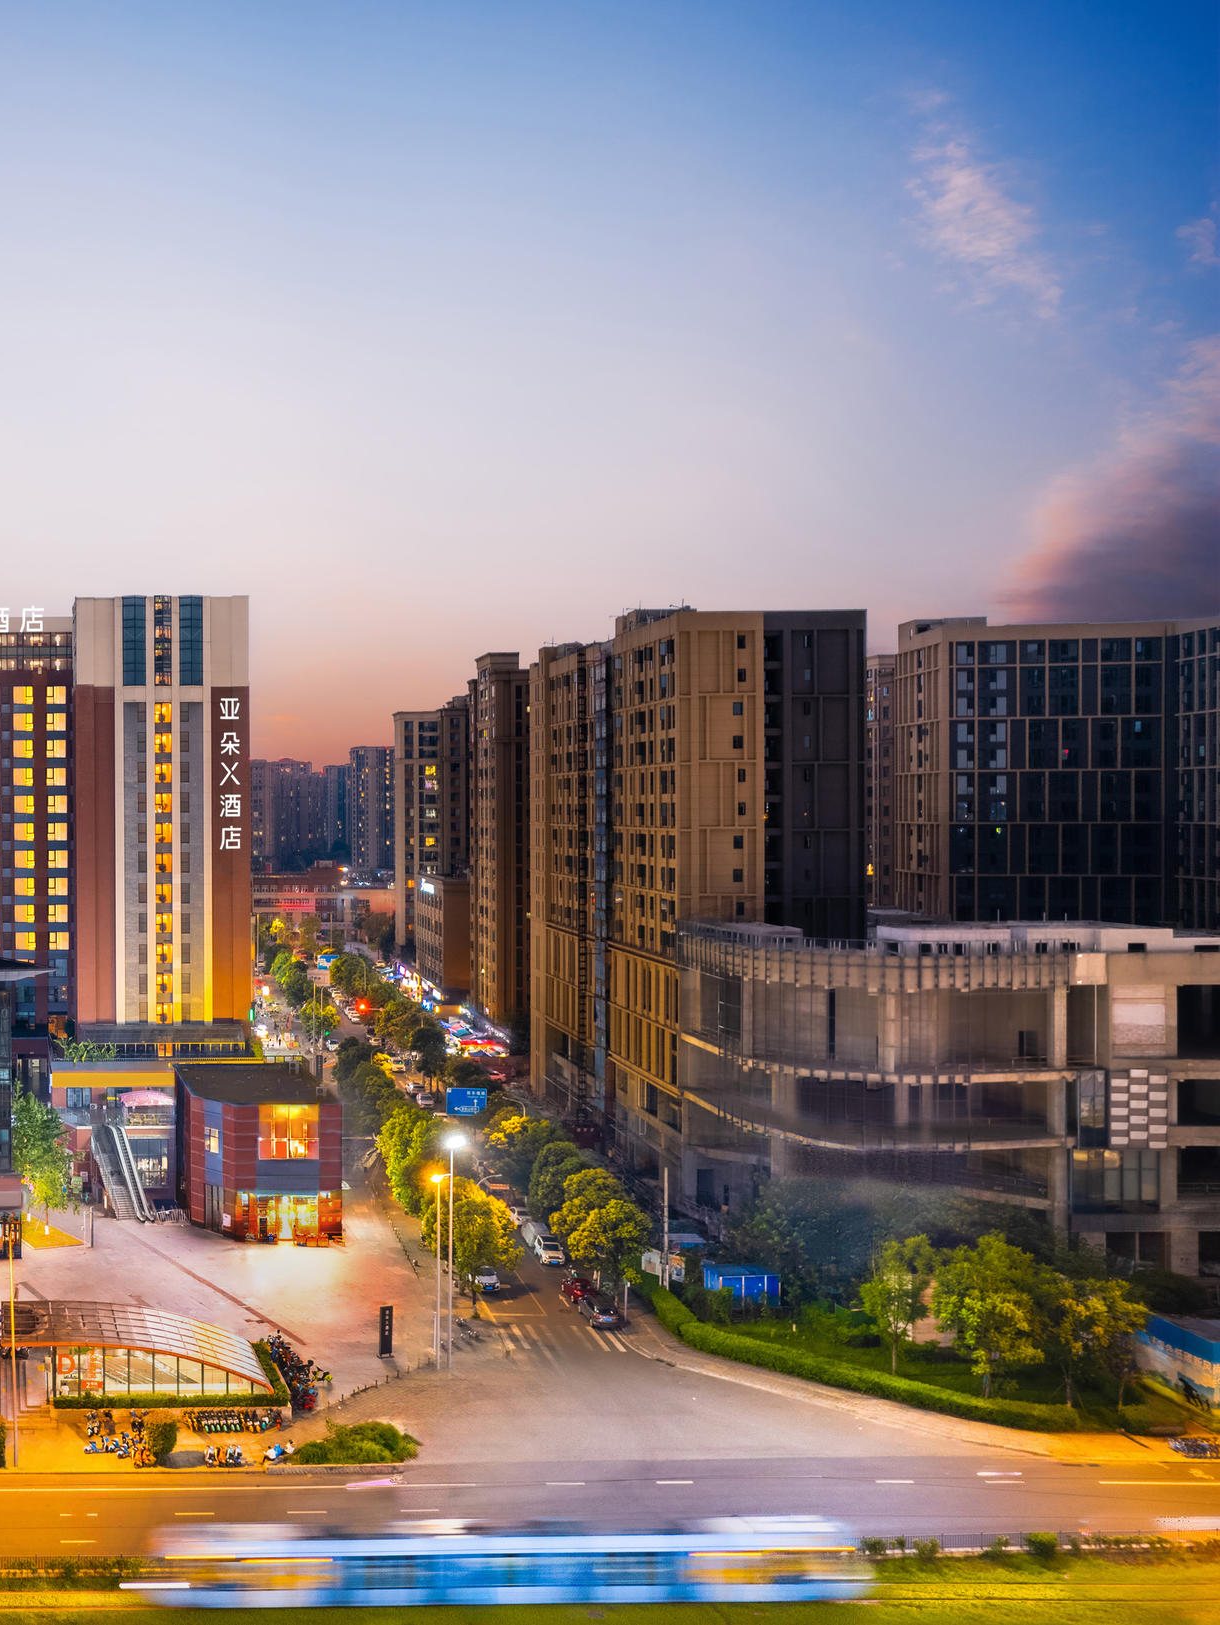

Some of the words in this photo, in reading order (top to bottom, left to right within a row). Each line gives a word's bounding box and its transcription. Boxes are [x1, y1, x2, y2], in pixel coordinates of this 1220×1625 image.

[219, 697, 242, 850] 亚朵X酒店
[57, 1354, 76, 1375] D
